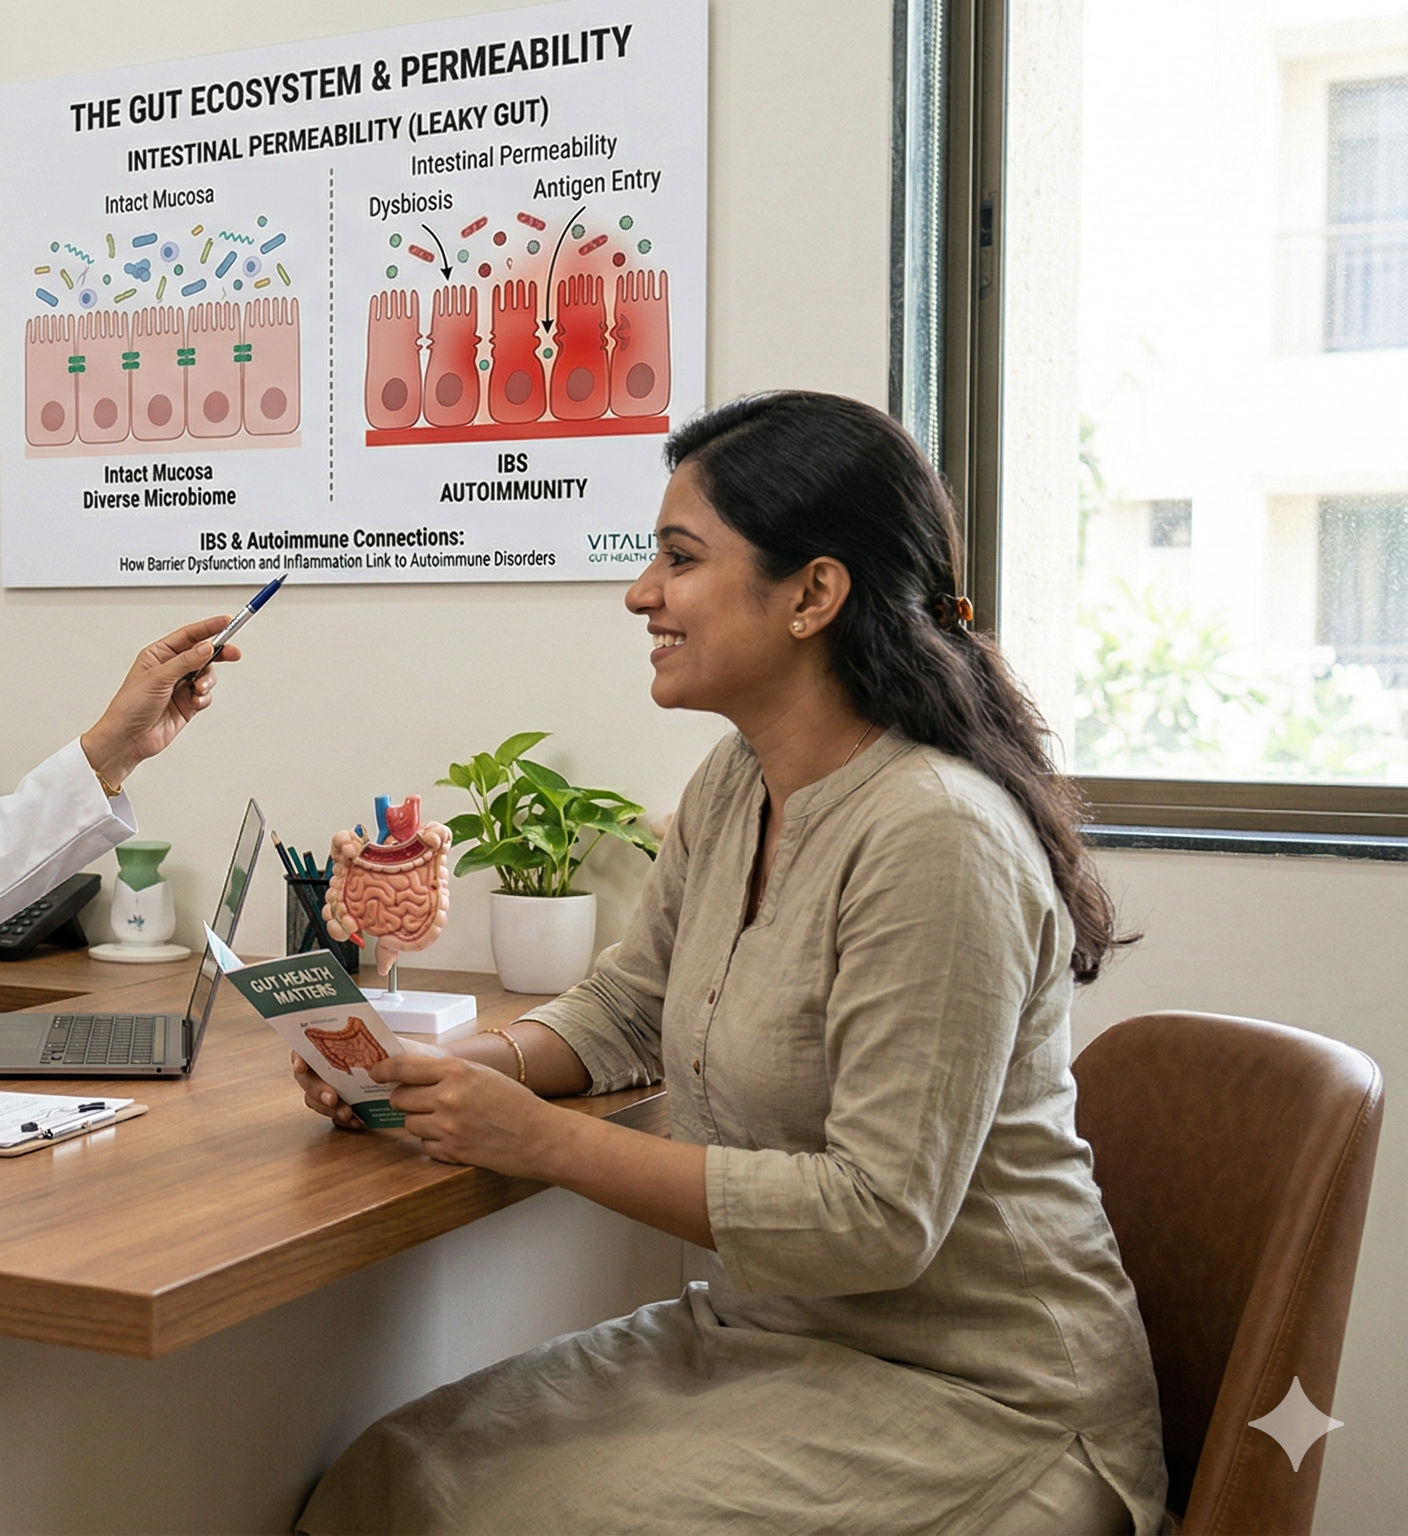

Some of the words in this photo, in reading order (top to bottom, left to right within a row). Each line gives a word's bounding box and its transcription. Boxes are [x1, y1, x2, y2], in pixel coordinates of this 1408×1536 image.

[70, 99, 121, 132] THE
[130, 89, 182, 123] GUT
[192, 64, 361, 116] ECOSYSTEM
[372, 60, 391, 91] &
[402, 25, 632, 87] PERMEABILITY
[128, 138, 243, 172] INTESTINAL
[250, 116, 402, 157] PERMEABILITY
[409, 105, 487, 142] (LEAKY
[494, 96, 548, 127] GUT)
[412, 146, 493, 175] Intestinal
[501, 134, 617, 166] Permeability
[533, 176, 605, 201] Antigen
[613, 169, 661, 193] Entry
[106, 193, 148, 214] Intact
[153, 189, 214, 209] Mucosa
[370, 190, 452, 221] Dysbiosis
[105, 466, 148, 483] Intact
[153, 464, 213, 481] Mucosa
[498, 453, 527, 473] IBS
[84, 490, 140, 509] Diverse
[145, 487, 236, 507] Microbiome
[440, 479, 587, 502] AUTOIMMUNITY
[201, 533, 227, 550] IBS
[231, 532, 242, 550] &
[247, 530, 349, 549] Autoimmune
[354, 527, 464, 547] Connections:
[120, 558, 144, 571] How
[148, 556, 185, 571] Barrier
[188, 555, 255, 574] Dysfunction
[259, 555, 280, 569] and
[284, 553, 362, 569] Inflammation
[366, 553, 391, 568] Link
[395, 554, 407, 568] to
[410, 552, 490, 567] Autoimmune
[495, 550, 555, 566] Disorders
[588, 553, 608, 563] GUT
[610, 552, 647, 562] HEALTH
[250, 976, 280, 993] GUT
[278, 966, 335, 987] HEALTH
[273, 983, 337, 1005] MATTERS
